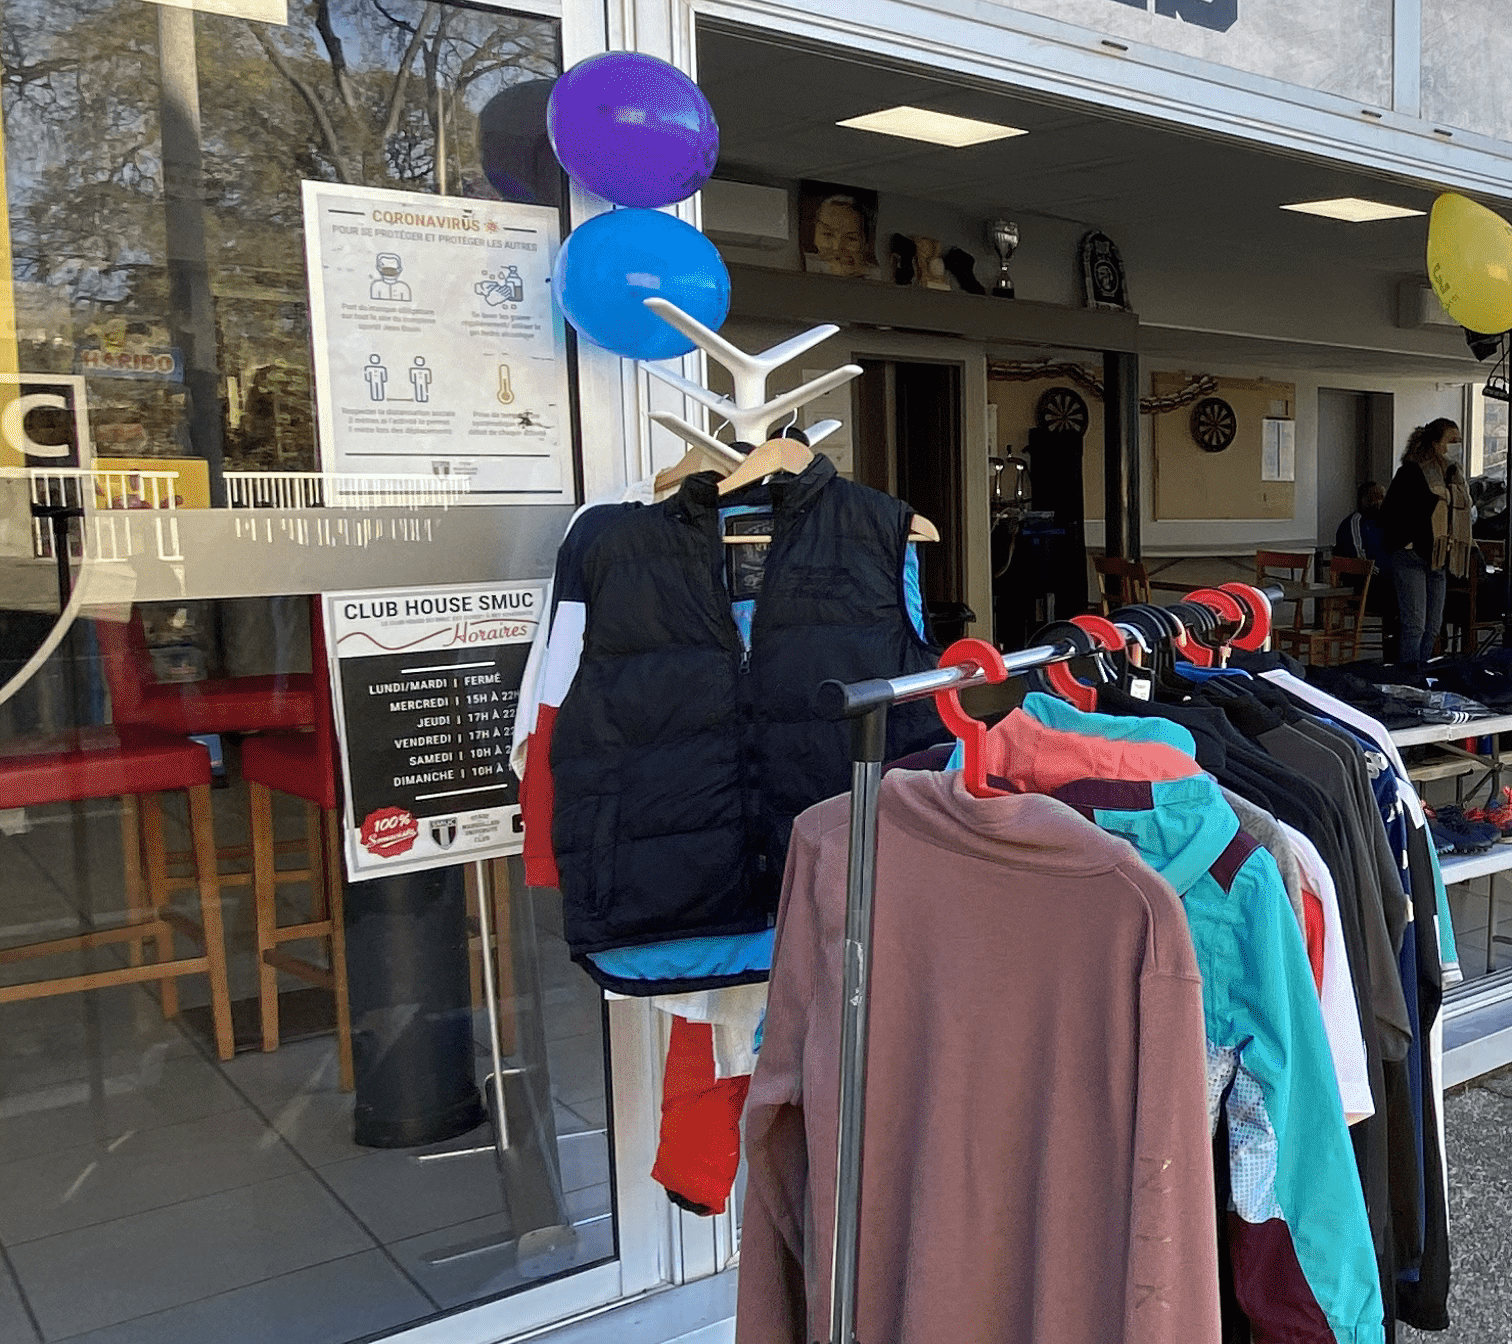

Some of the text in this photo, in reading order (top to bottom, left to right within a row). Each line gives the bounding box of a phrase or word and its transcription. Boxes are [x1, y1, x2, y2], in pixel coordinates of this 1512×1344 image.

[372, 209, 480, 233] CORONAVIRUS
[332, 224, 359, 236] POUR
[425, 233, 436, 242] ET
[487, 239, 502, 249] LES
[504, 241, 538, 252] AUTRES
[344, 601, 398, 620] CLUB
[406, 596, 473, 616] HOUSE
[478, 592, 534, 611] SMUC
[443, 621, 528, 647] Horaires
[368, 672, 501, 696] LUNDI/MARDI FERMÉ
[389, 697, 449, 712] MERCREDI
[466, 693, 488, 705] 15H
[416, 715, 450, 728] JEUDI
[467, 711, 489, 723] 17H
[502, 708, 517, 719] 22
[394, 734, 451, 749] VENDREDI
[469, 729, 490, 741] 17H
[409, 752, 453, 766] SAMEDI
[470, 748, 491, 759] 10H
[393, 769, 455, 787] DIMANCHE
[472, 765, 493, 777] 10H
[374, 812, 411, 833] 100%
